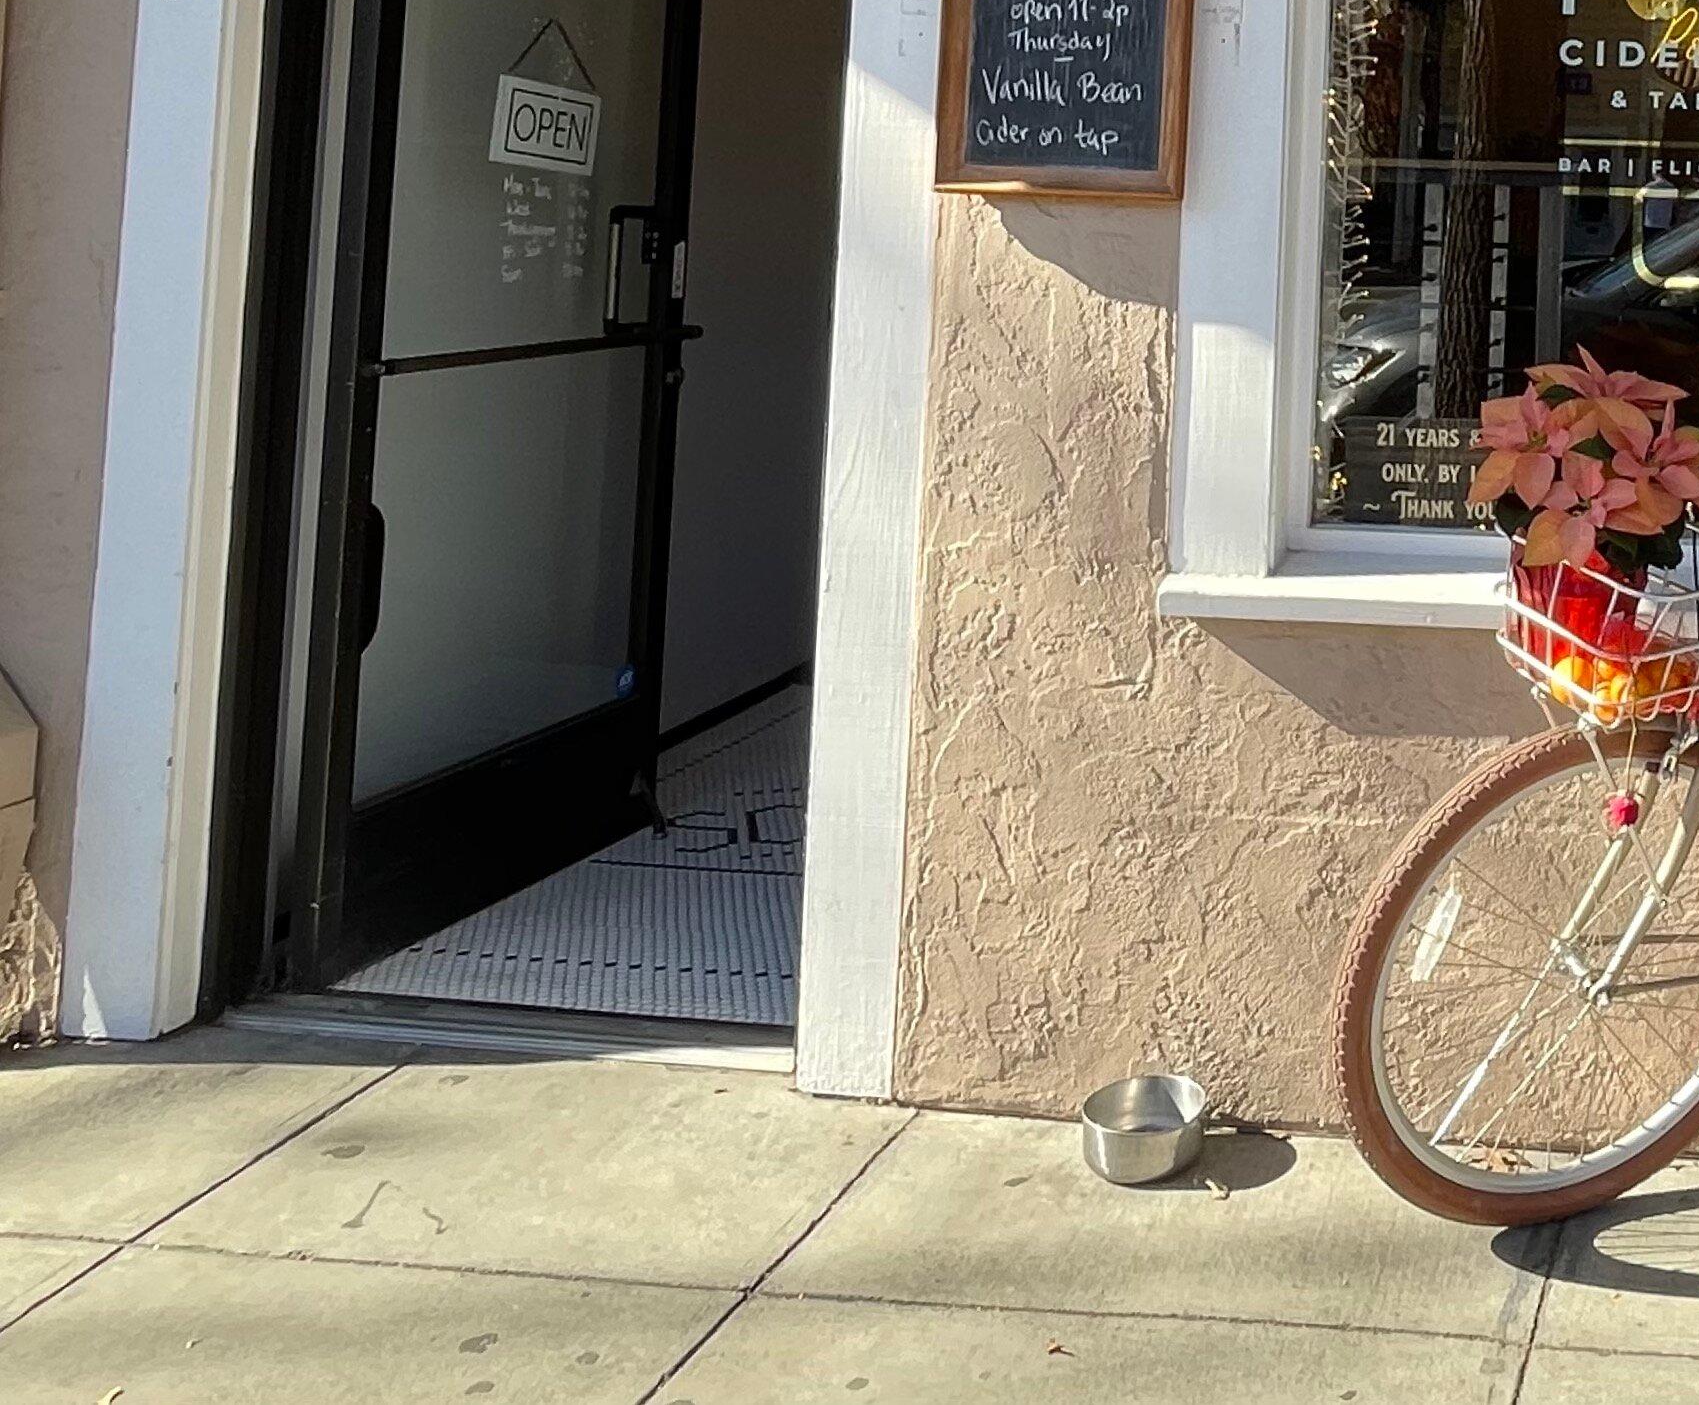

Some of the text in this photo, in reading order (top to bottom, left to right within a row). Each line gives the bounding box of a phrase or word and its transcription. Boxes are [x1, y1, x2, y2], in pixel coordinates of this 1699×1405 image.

[1008, 27, 1112, 62] Thursday
[982, 65, 1143, 107] Vanilla Bean
[1610, 90, 1627, 109] &
[512, 103, 588, 151] OPEN
[1038, 125, 1063, 146] on
[1074, 118, 1120, 155] tap
[1558, 157, 1611, 174] BAR
[1376, 422, 1396, 447] 21
[1404, 428, 1461, 448] YEARS
[1381, 462, 1430, 484] ONLY.
[1438, 464, 1461, 484] BY
